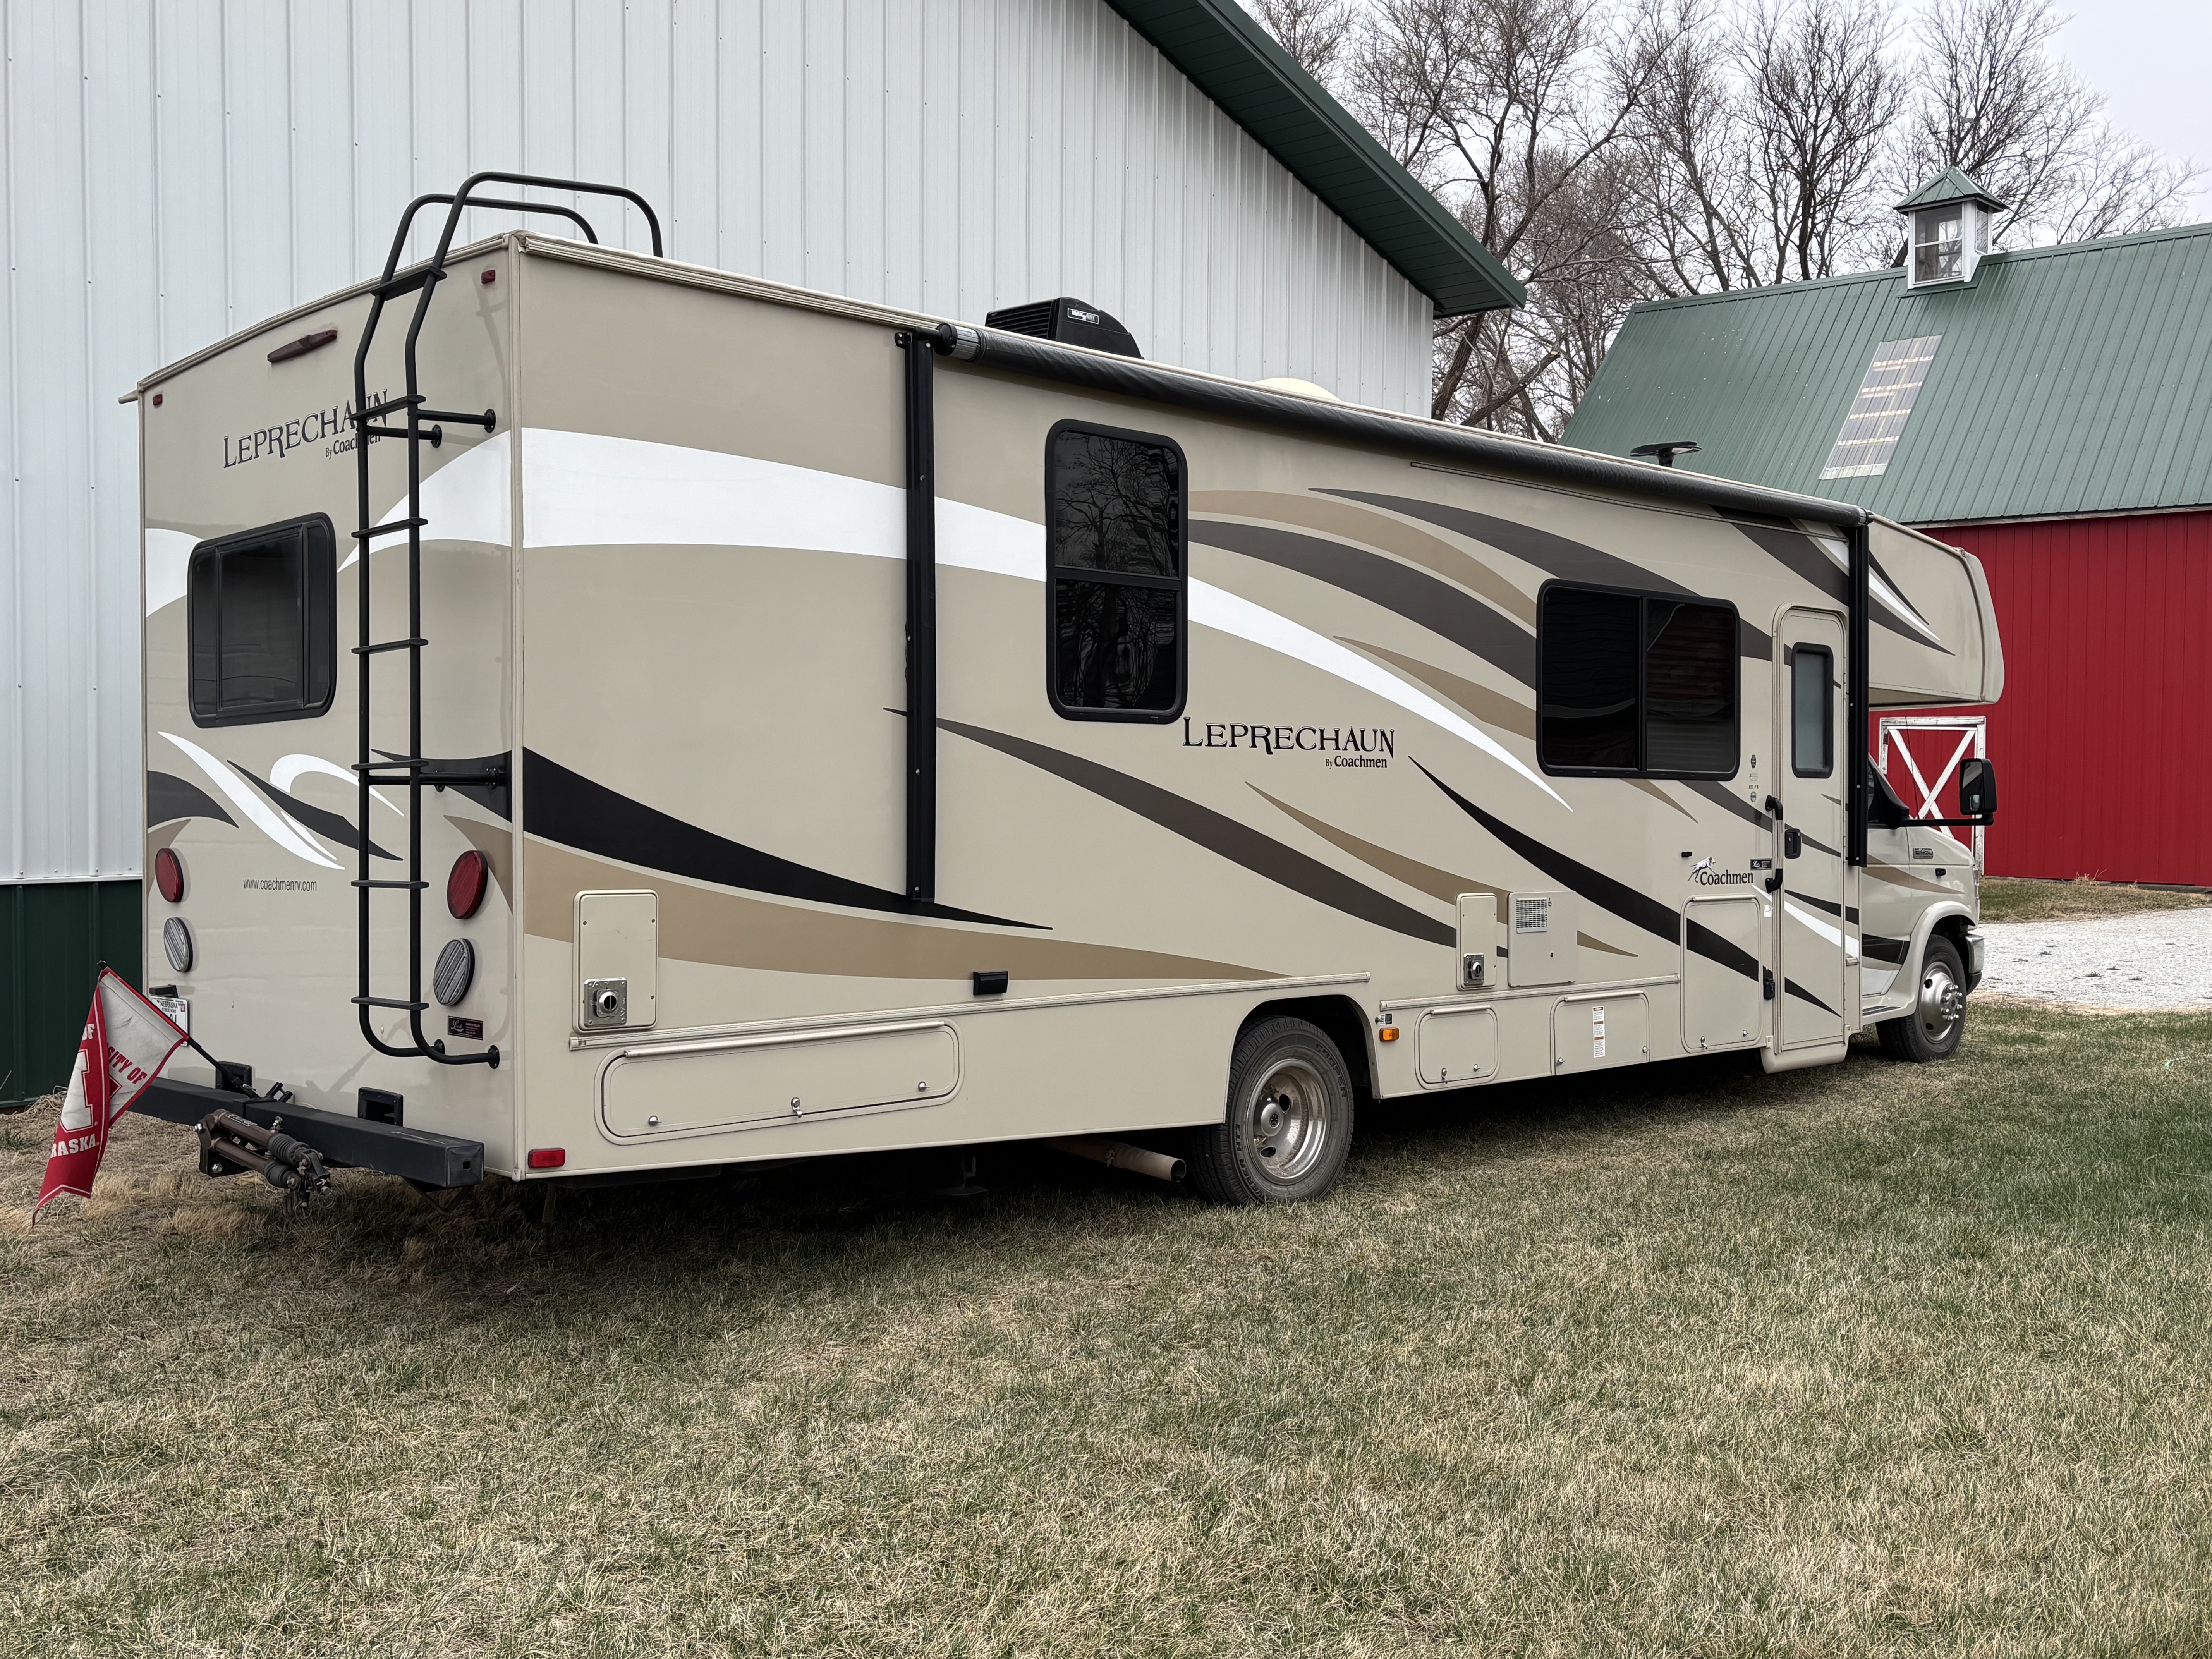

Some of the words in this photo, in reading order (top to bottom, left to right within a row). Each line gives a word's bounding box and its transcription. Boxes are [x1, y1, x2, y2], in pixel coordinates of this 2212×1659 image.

[223, 388, 387, 468] LEPRECHAN
[326, 447, 332, 460] By
[1182, 716, 1395, 759] LEPRECHAUN
[1325, 758, 1333, 769] By
[1334, 755, 1387, 768] Coachmen
[243, 877, 317, 891] www.coachmenrv.com
[1700, 869, 1754, 886] Coachmen
[127, 1067, 148, 1085] OF
